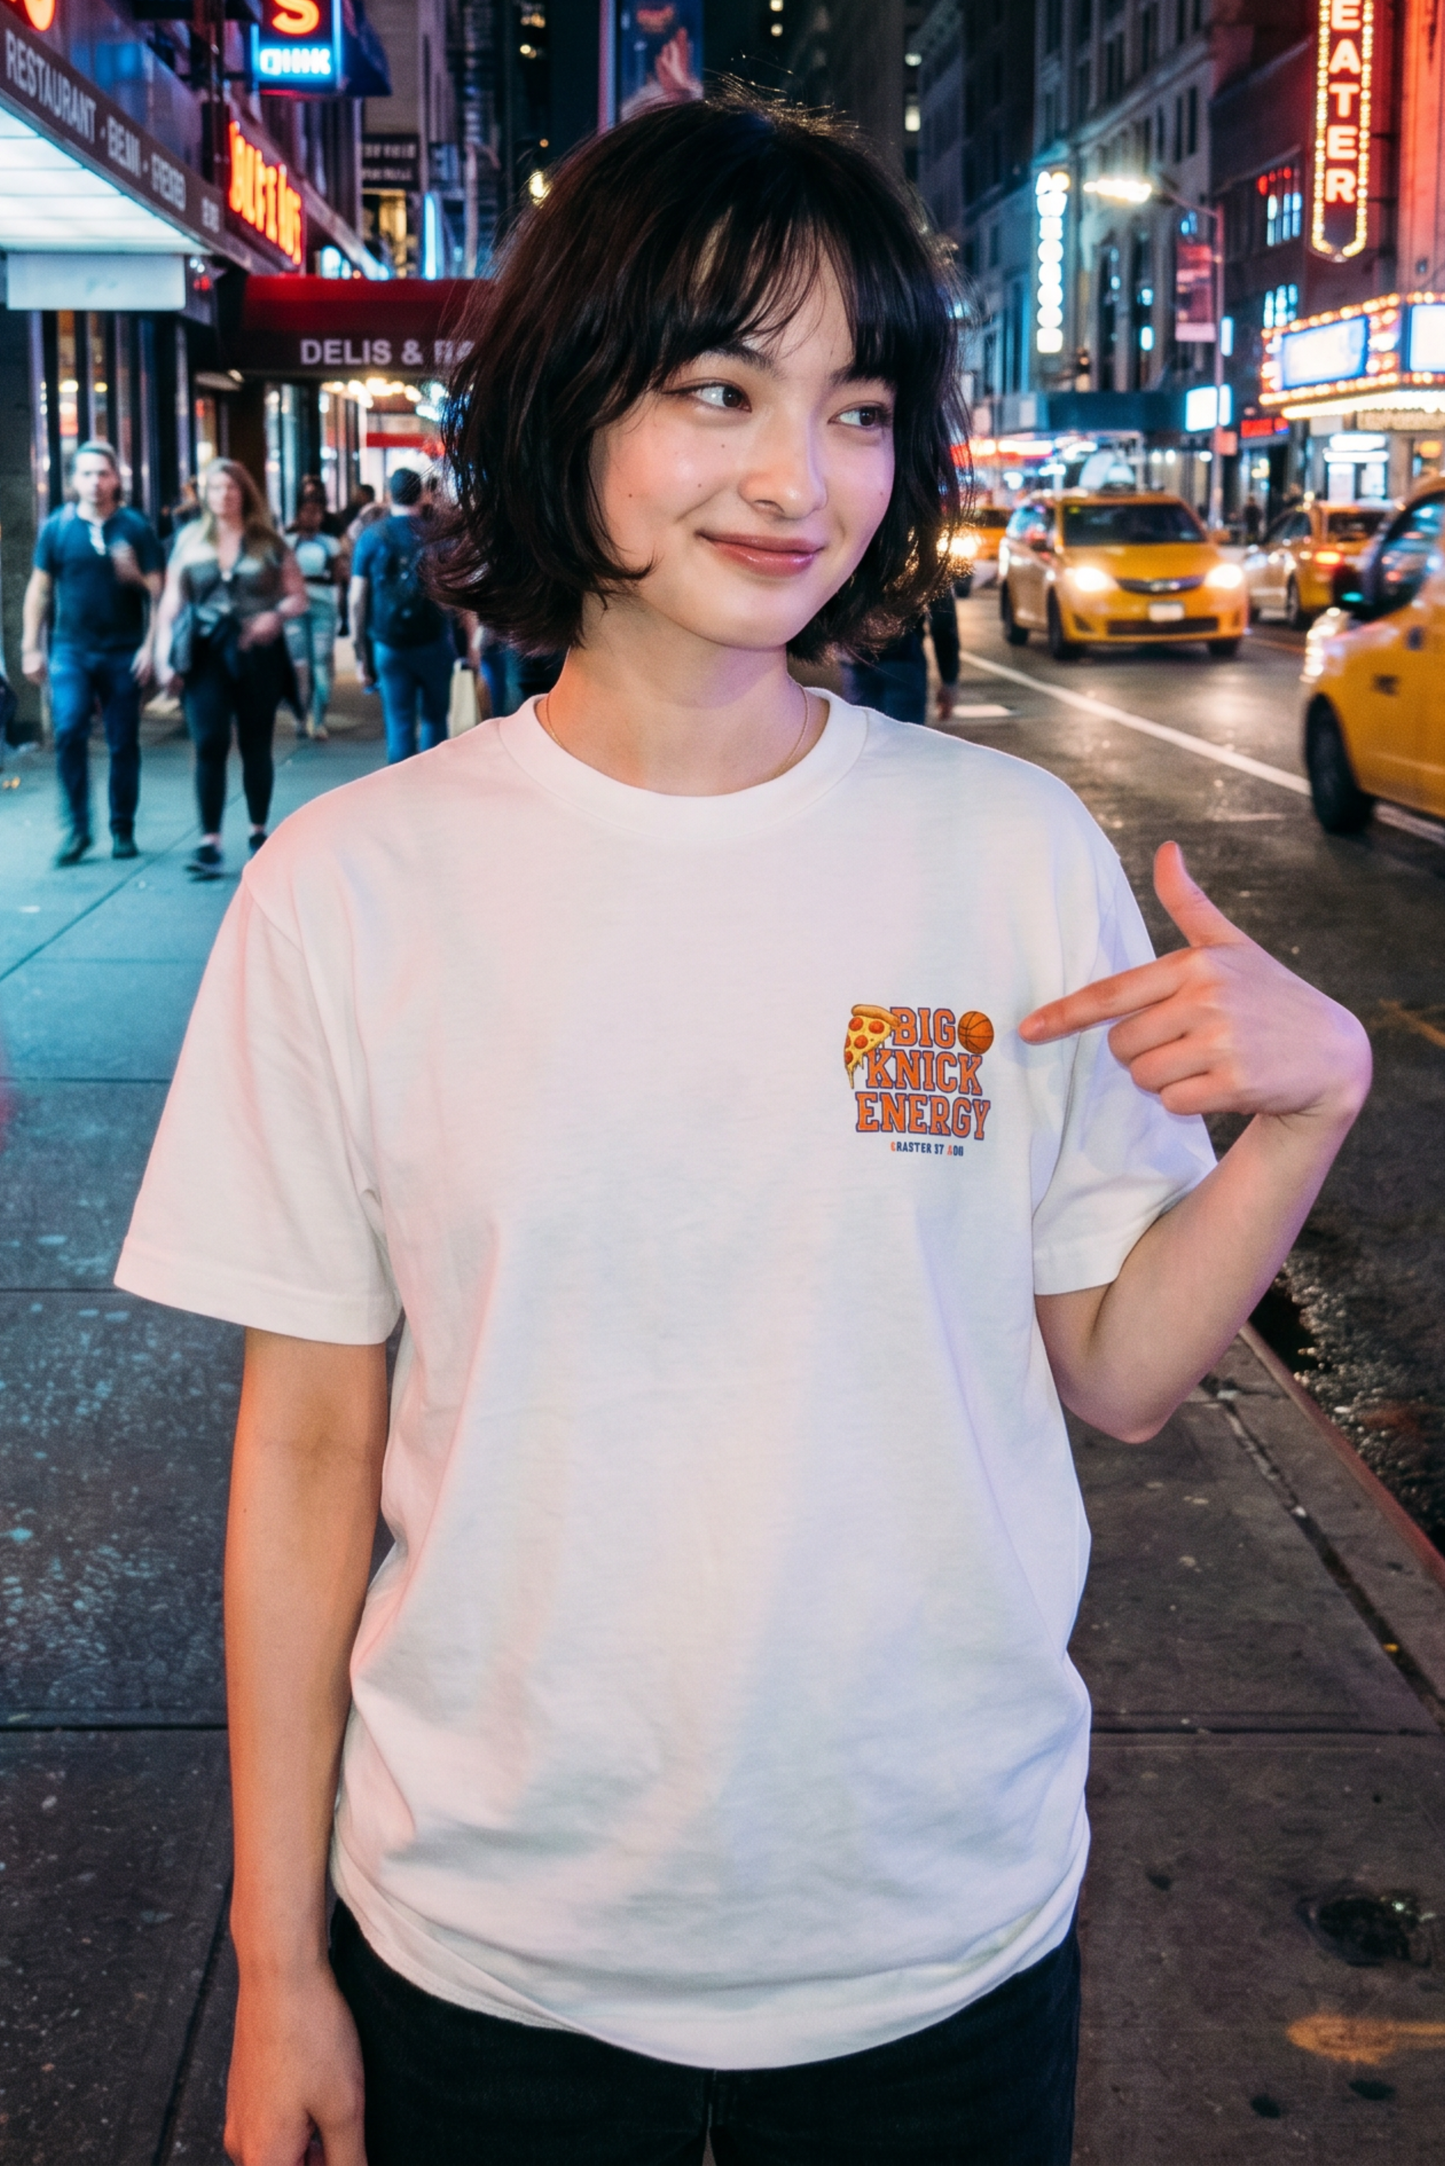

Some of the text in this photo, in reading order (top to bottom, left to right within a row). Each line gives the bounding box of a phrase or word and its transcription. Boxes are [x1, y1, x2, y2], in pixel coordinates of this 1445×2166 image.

[6, 28, 96, 144] RESTAURANT
[301, 338, 393, 365] DELIS
[401, 338, 423, 365] &
[890, 1007, 956, 1049] BIG
[865, 1049, 983, 1096] KNICK
[855, 1091, 991, 1140] ENERGY
